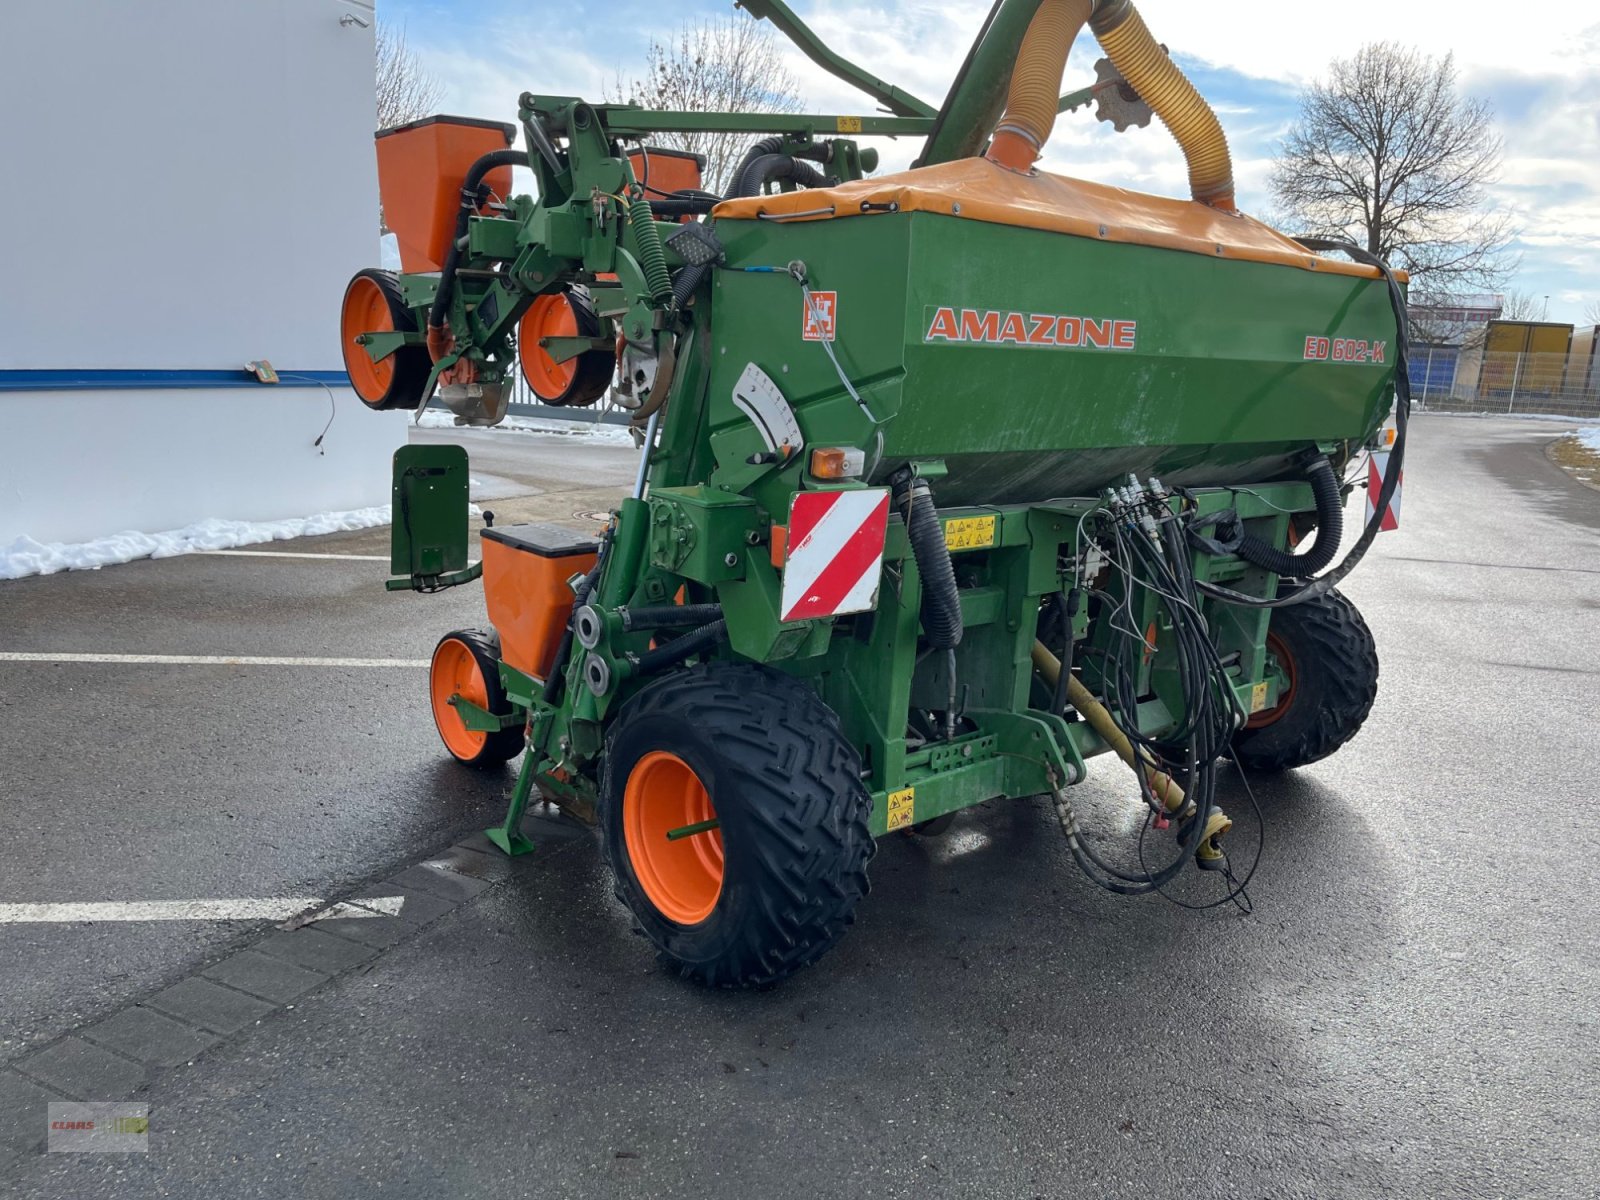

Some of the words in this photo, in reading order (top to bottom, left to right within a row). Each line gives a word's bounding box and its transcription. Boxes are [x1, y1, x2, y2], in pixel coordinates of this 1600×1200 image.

[925, 307, 1137, 349] AMAZONE
[1303, 335, 1330, 360] ED
[1332, 338, 1387, 363] 602-K
